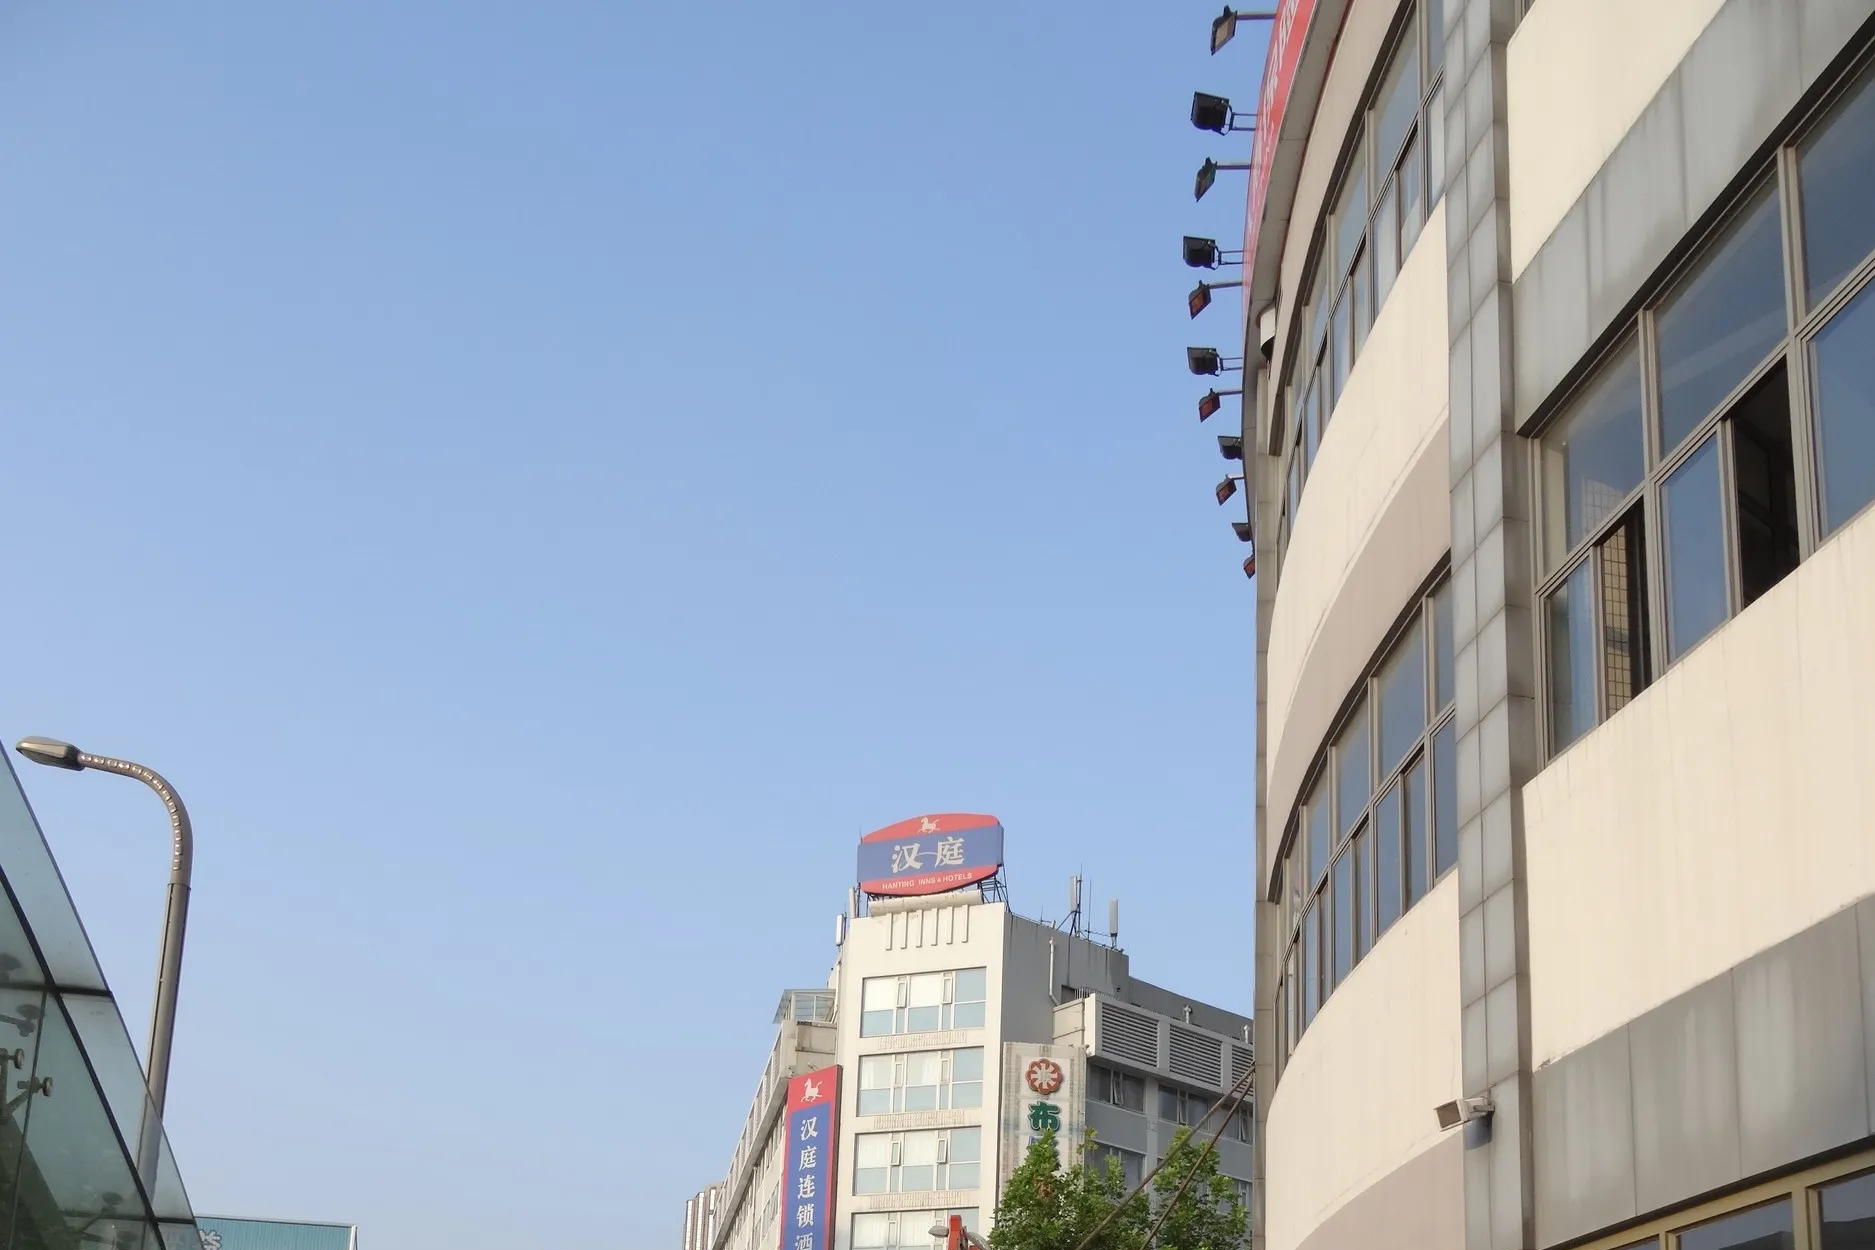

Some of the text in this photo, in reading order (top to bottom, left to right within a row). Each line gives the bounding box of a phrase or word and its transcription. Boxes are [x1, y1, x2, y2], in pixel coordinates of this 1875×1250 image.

[891, 836, 965, 874] 汉庭
[882, 880, 915, 890] HANTING
[918, 878, 936, 886] INNS
[942, 872, 973, 882] HOTELS
[1027, 1100, 1061, 1132] 布
